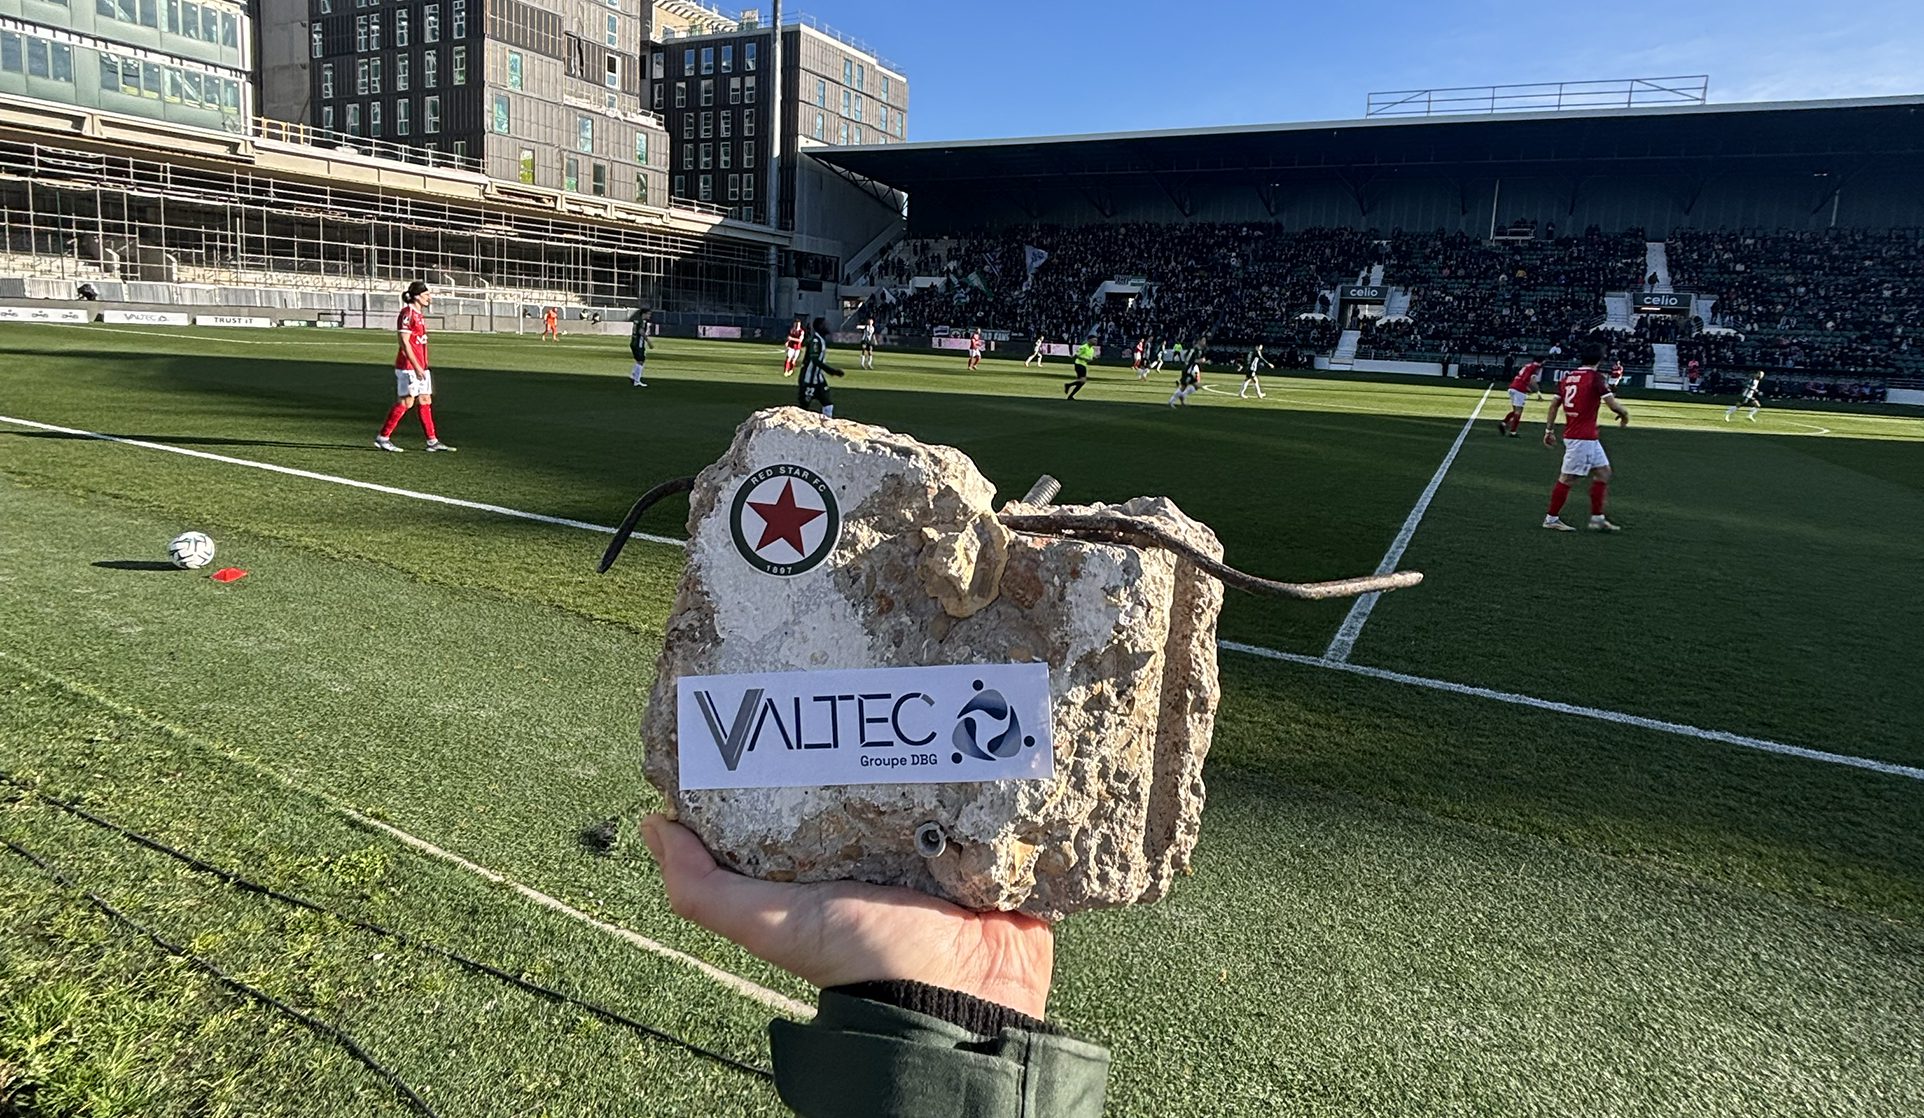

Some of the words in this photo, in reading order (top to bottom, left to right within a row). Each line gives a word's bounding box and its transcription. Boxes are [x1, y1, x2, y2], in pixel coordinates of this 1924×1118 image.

[1350, 287, 1378, 297] celio
[1643, 294, 1678, 305] celio
[1564, 385, 1577, 408] 12
[750, 468, 773, 485] RED
[779, 466, 810, 479] STAR
[812, 479, 826, 493] FC
[766, 564, 793, 575] 1897
[693, 688, 938, 772] VALTEC
[860, 755, 907, 769] Groupe
[910, 753, 938, 766] DBG
